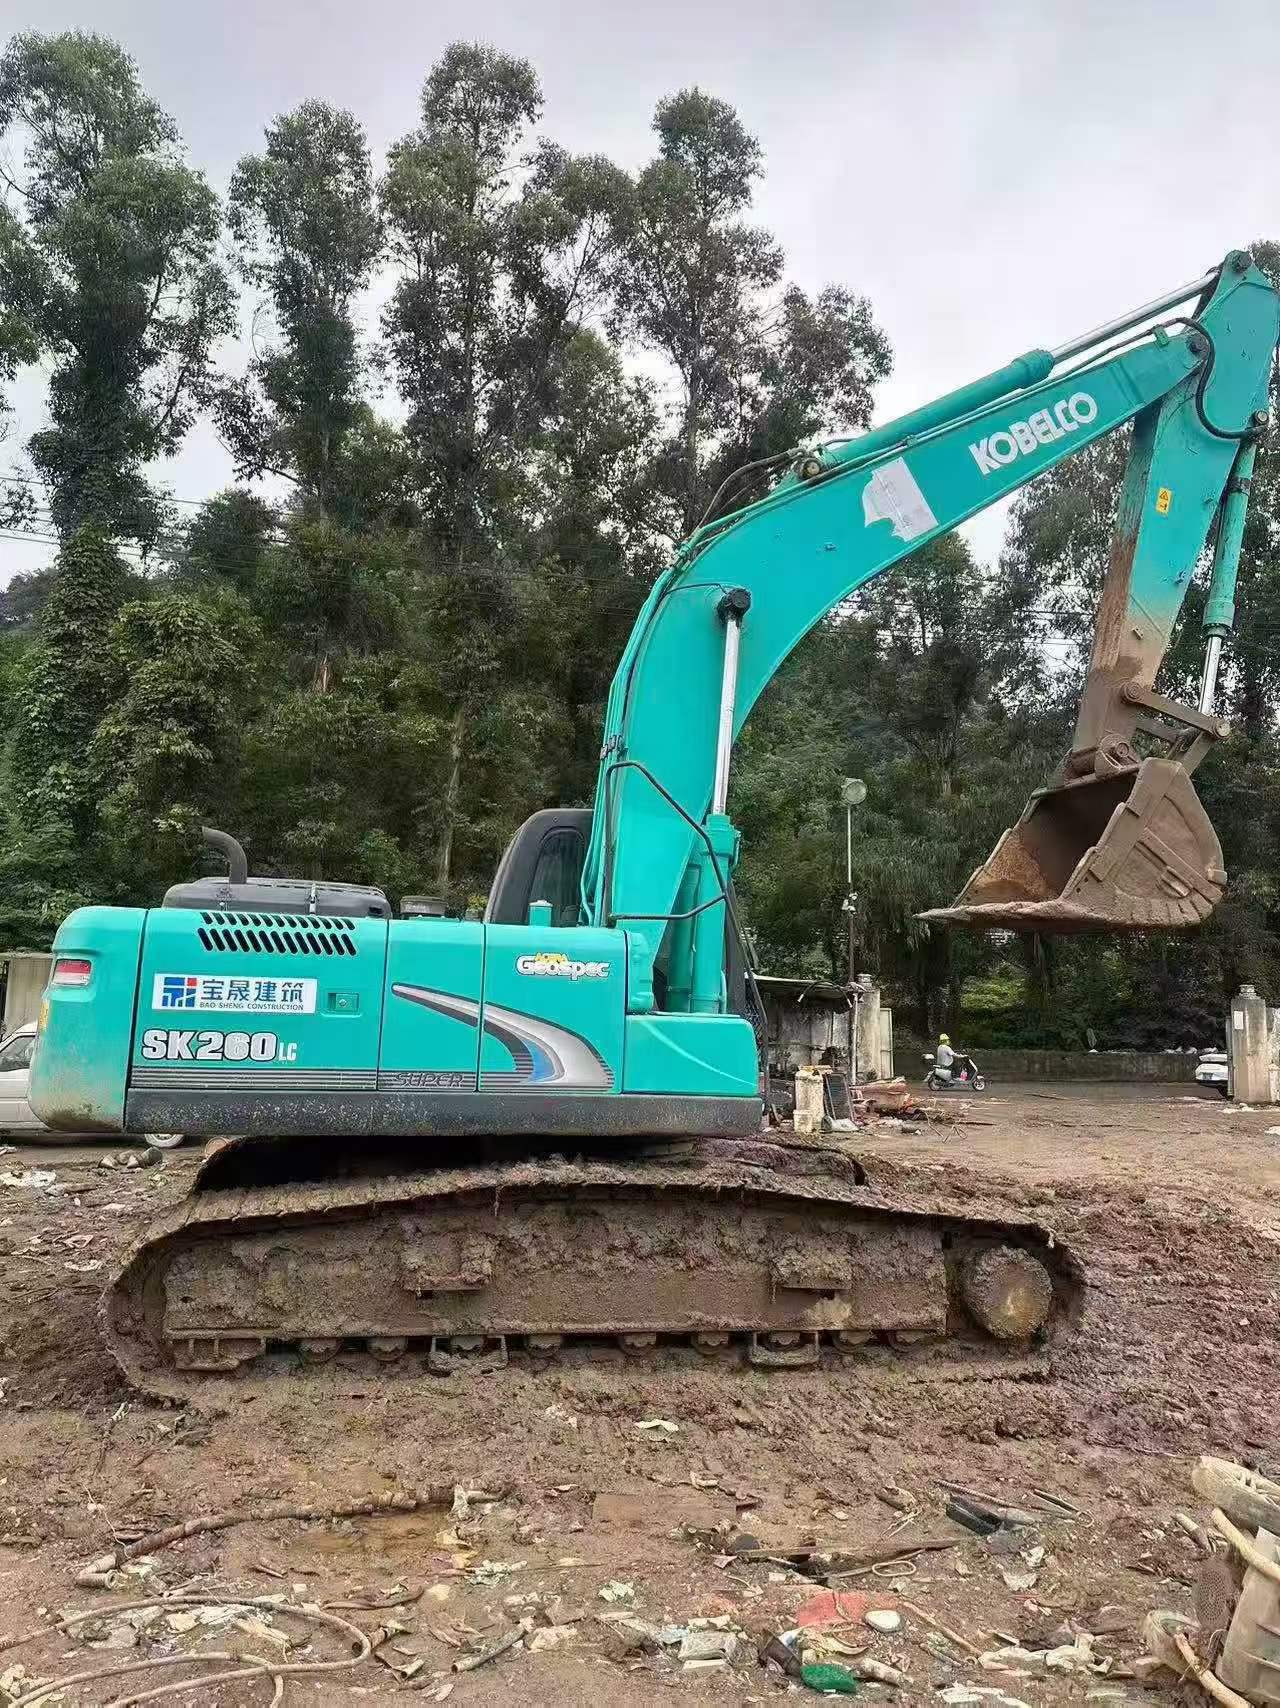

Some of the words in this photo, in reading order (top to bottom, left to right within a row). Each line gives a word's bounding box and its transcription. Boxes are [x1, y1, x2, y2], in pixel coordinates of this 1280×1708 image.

[968, 391, 1098, 475] KOBELCO
[200, 979, 304, 1002] 宝晟建筑
[247, 1003, 304, 1011] CONSTRUCTION
